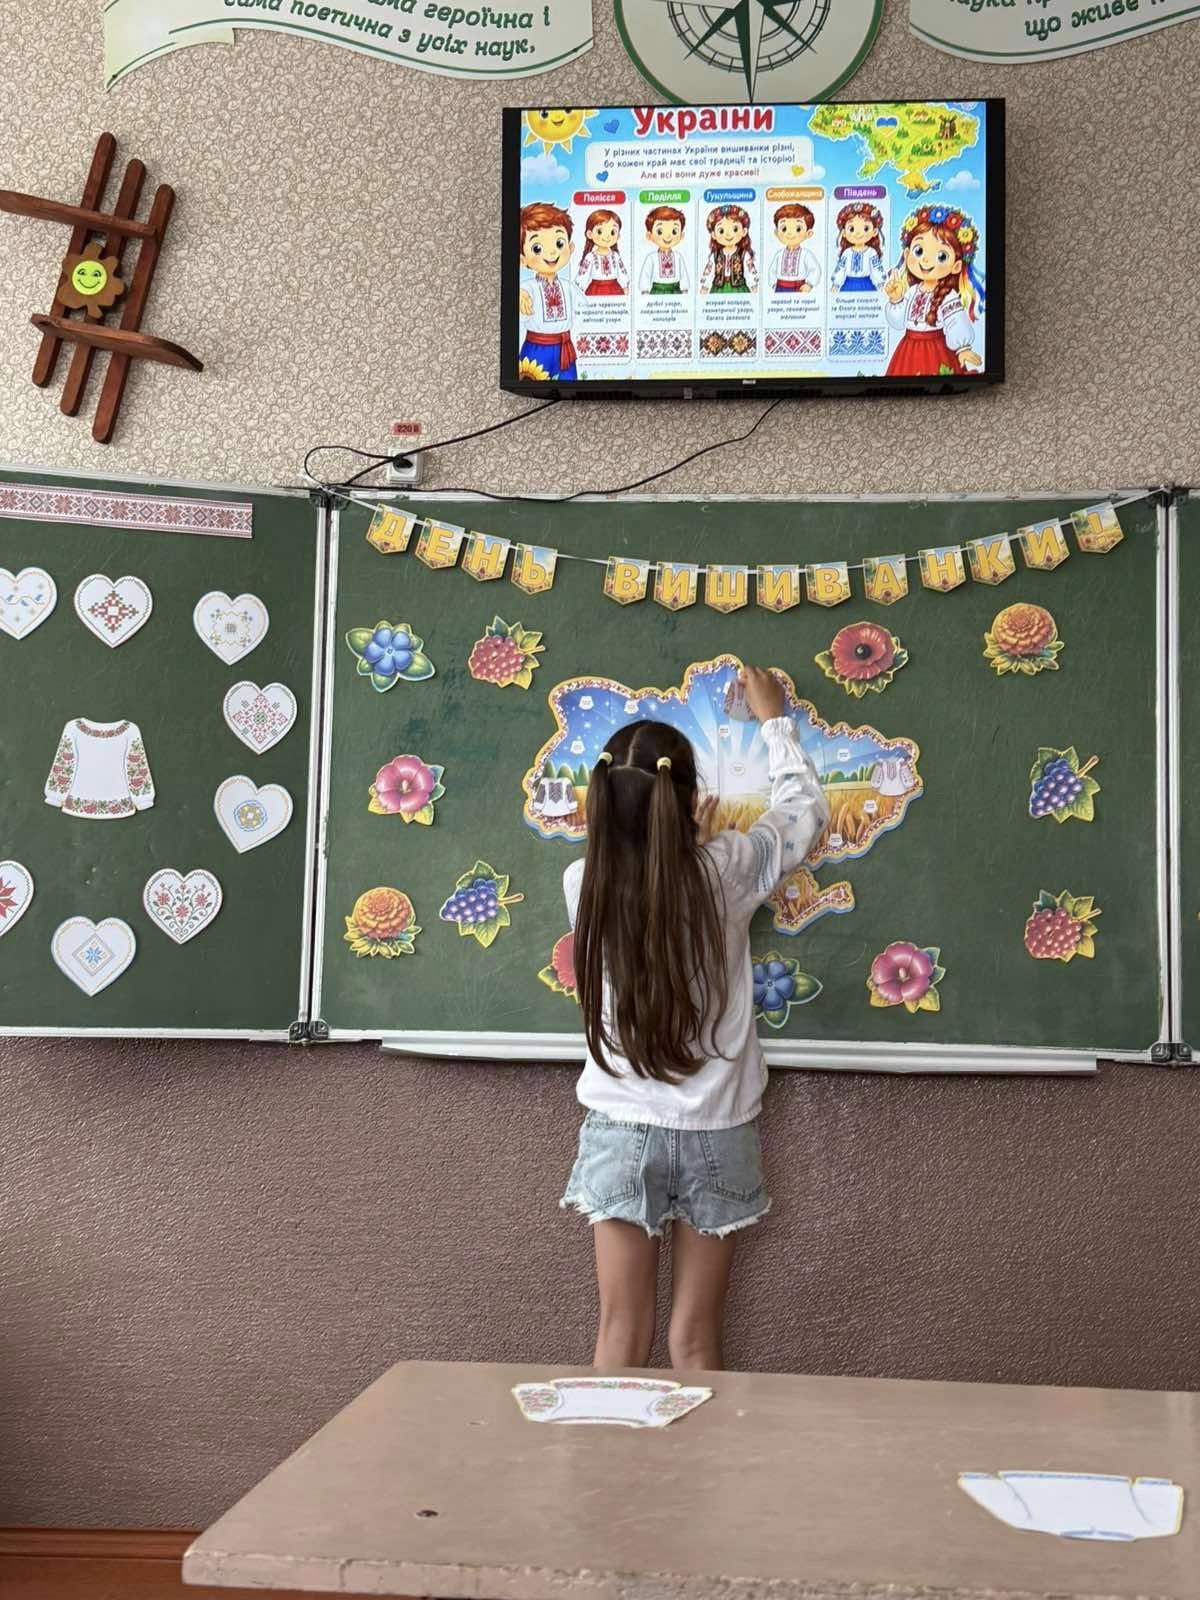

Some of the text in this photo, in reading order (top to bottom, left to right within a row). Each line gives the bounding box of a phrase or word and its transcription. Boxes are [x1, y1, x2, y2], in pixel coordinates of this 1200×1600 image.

[424, 3, 534, 28] героїчна
[543, 6, 551, 27] і
[1025, 0, 1139, 41] що живе
[290, 0, 393, 38] поетична
[398, 29, 411, 43] з
[416, 33, 468, 54] усіх
[475, 39, 536, 61] наук,
[685, 144, 719, 155] України
[721, 144, 769, 153] вишиванки
[640, 170, 658, 179] Але
[583, 192, 616, 203] Полісся
[648, 191, 683, 202] Поділля
[843, 188, 877, 199] Південь
[373, 511, 1107, 604] ДЕНЬ ВИШИВАНКИ!
